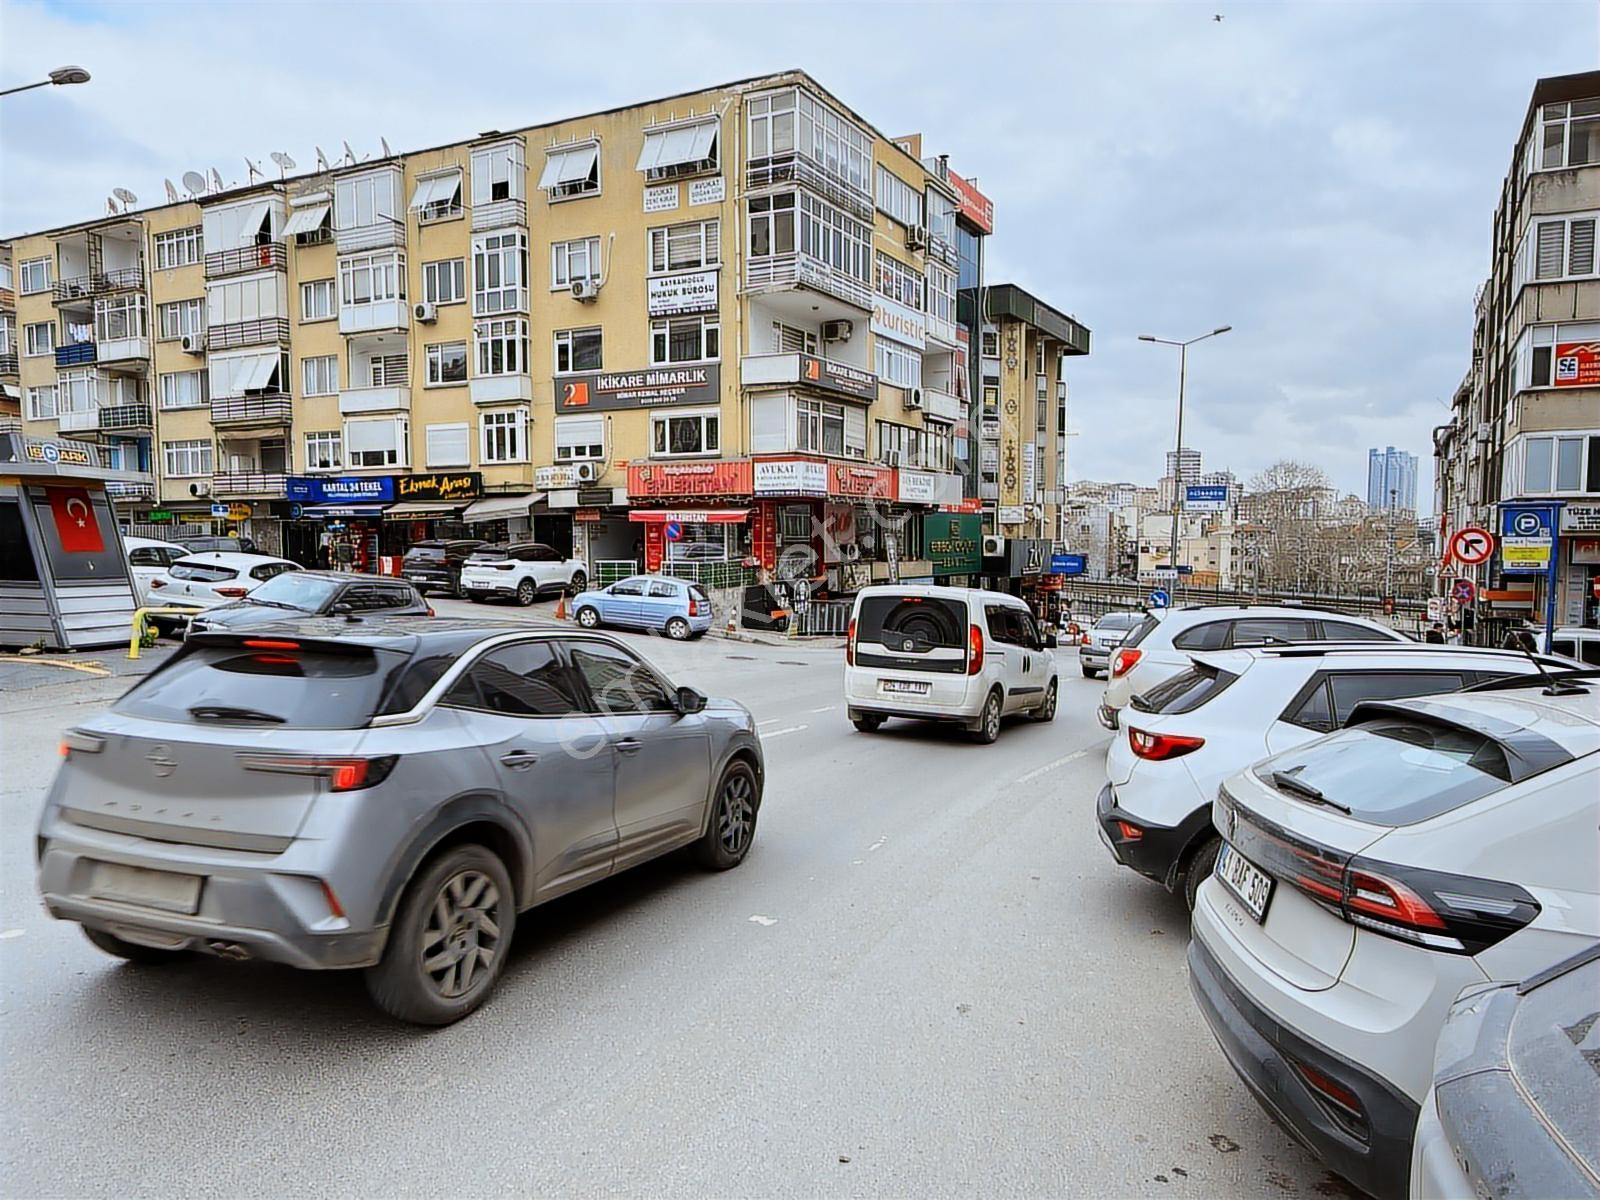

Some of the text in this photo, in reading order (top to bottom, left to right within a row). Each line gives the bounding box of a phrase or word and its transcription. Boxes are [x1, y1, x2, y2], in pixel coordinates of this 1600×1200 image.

[651, 288, 678, 299] HUKUK
[681, 284, 715, 295] BÜROSU
[597, 369, 706, 390] İKİKARE MİMARLIK
[760, 463, 795, 475] AVUKAT
[322, 482, 348, 492] KARTAL
[360, 481, 383, 491] TEKEL
[400, 477, 438, 495] Ekmek
[440, 476, 472, 495] Arası
